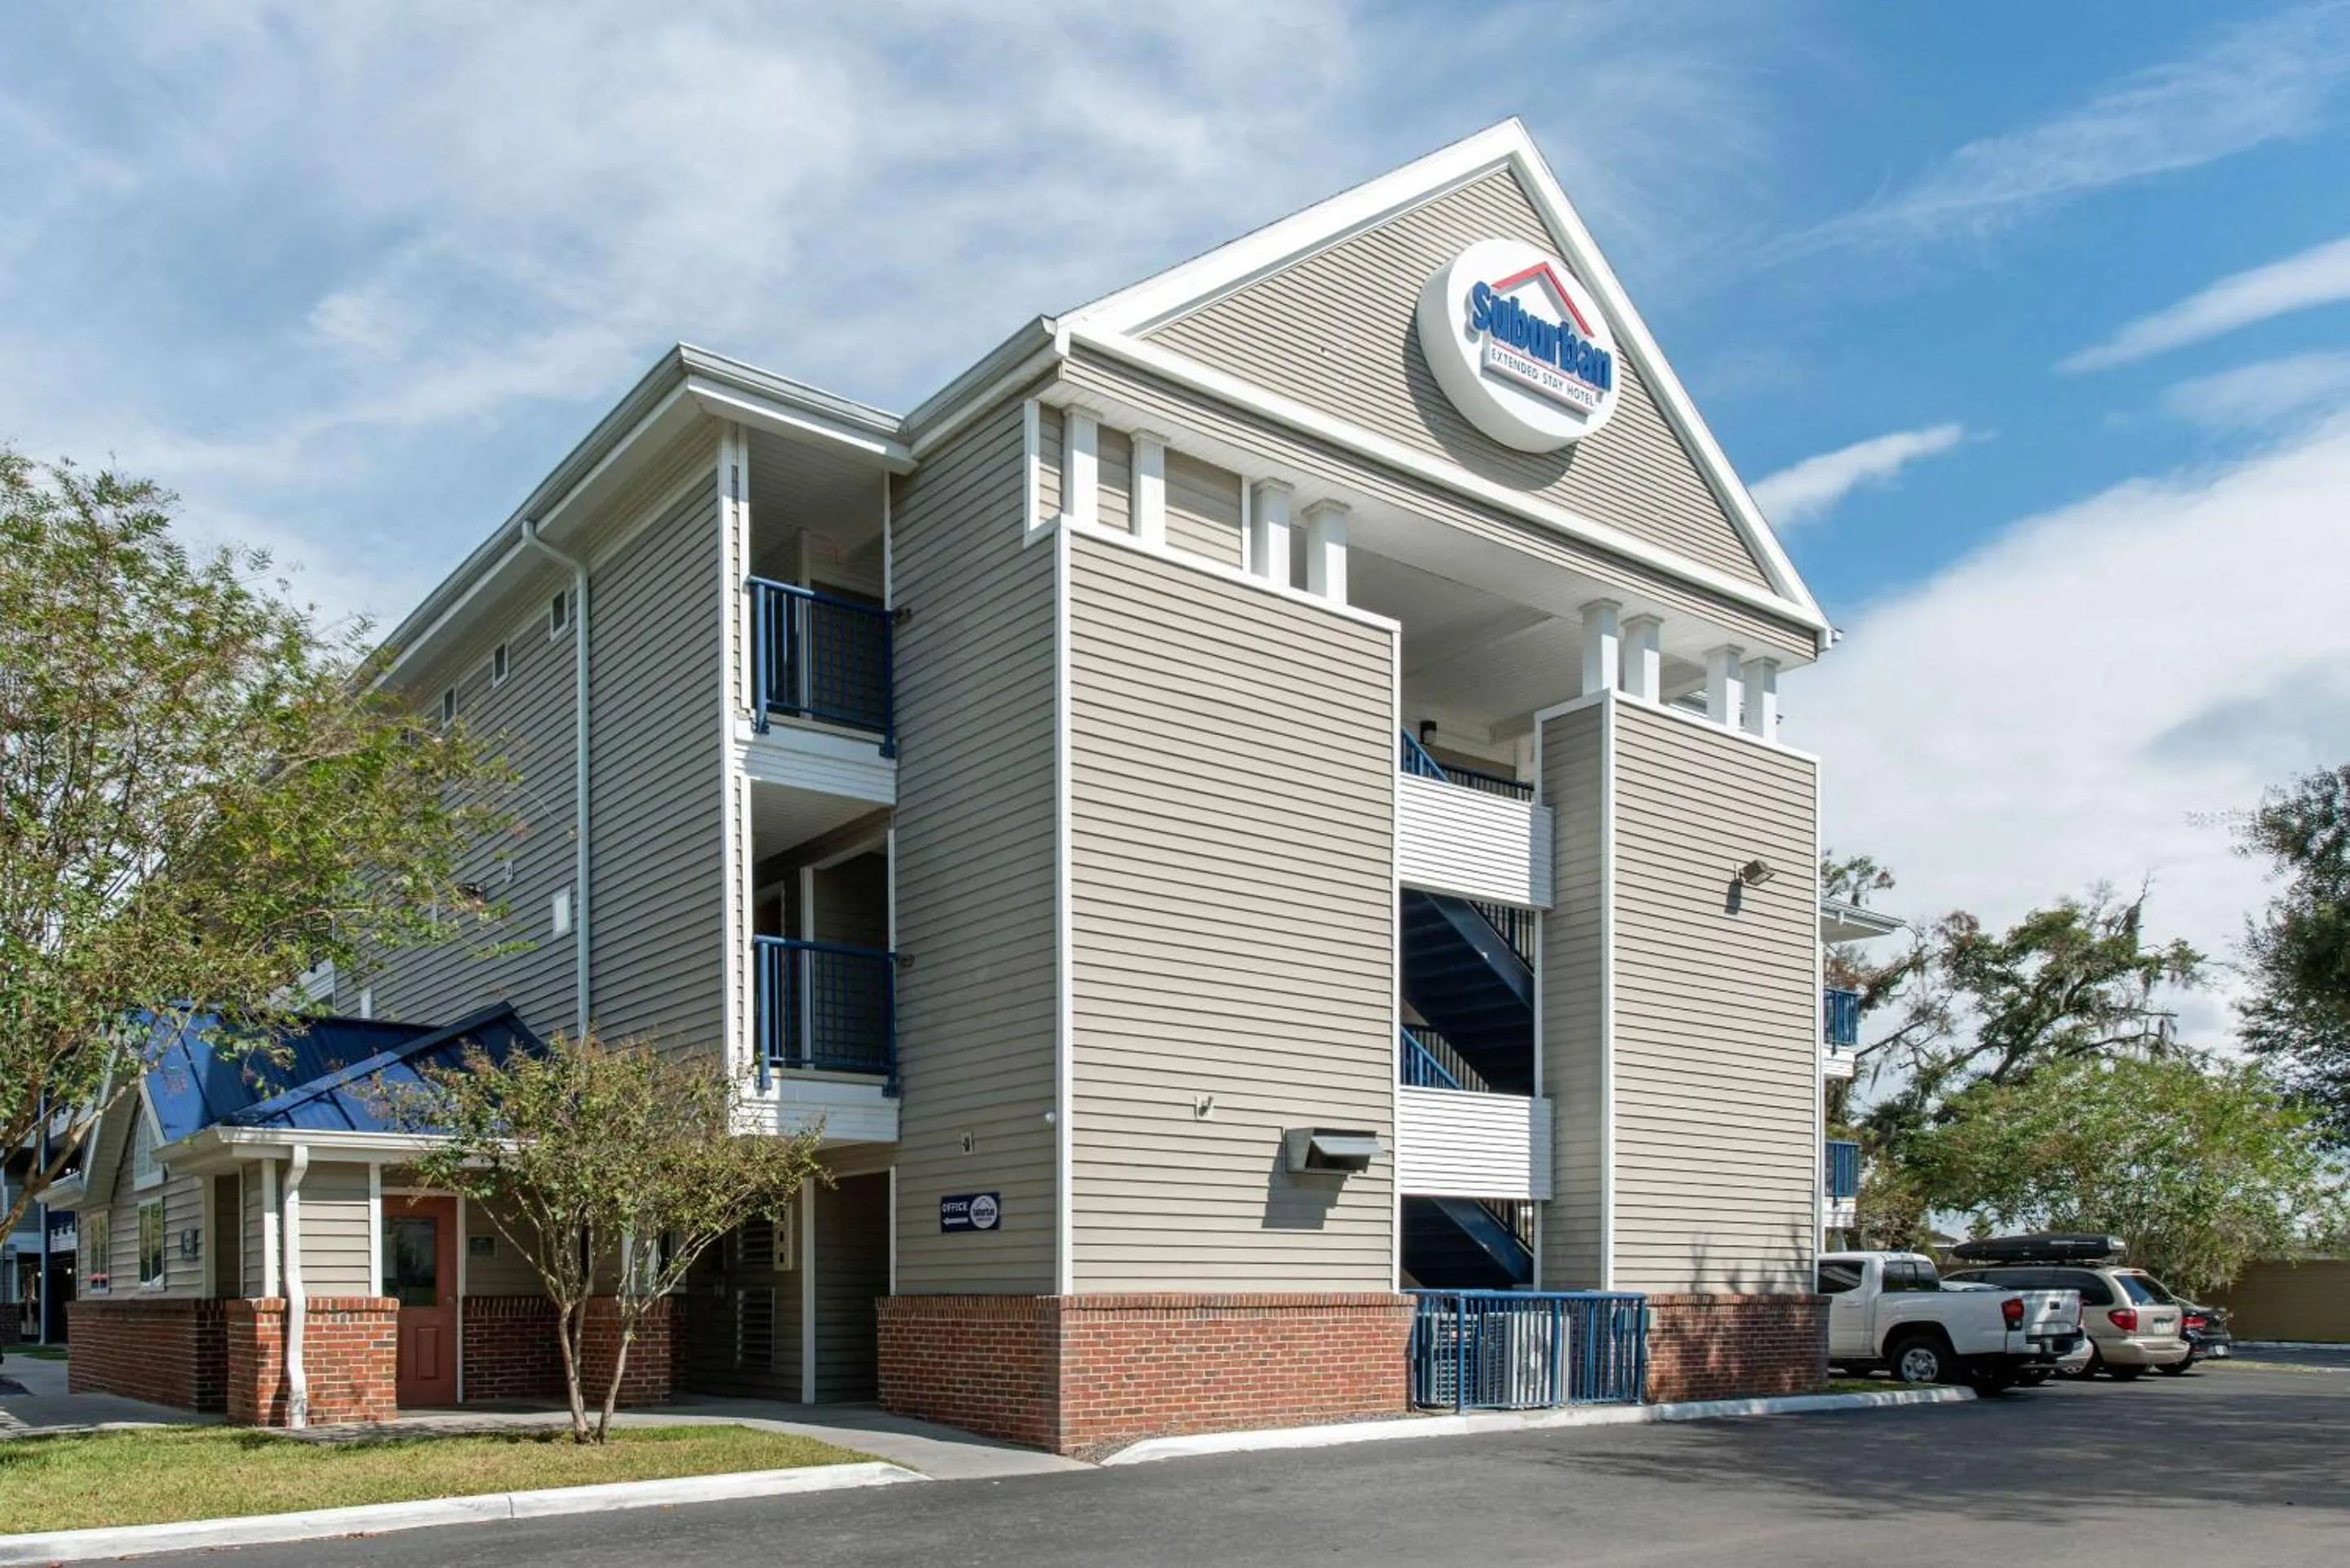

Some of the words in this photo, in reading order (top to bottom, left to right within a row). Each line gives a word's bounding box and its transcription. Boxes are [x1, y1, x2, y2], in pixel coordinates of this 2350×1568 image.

[1472, 281, 1612, 392] Suburban
[1492, 348, 1538, 379] EXTENDED
[1543, 372, 1563, 390] STAY
[1567, 383, 1594, 406] HOTEL
[942, 1201, 969, 1213] OFFICE
